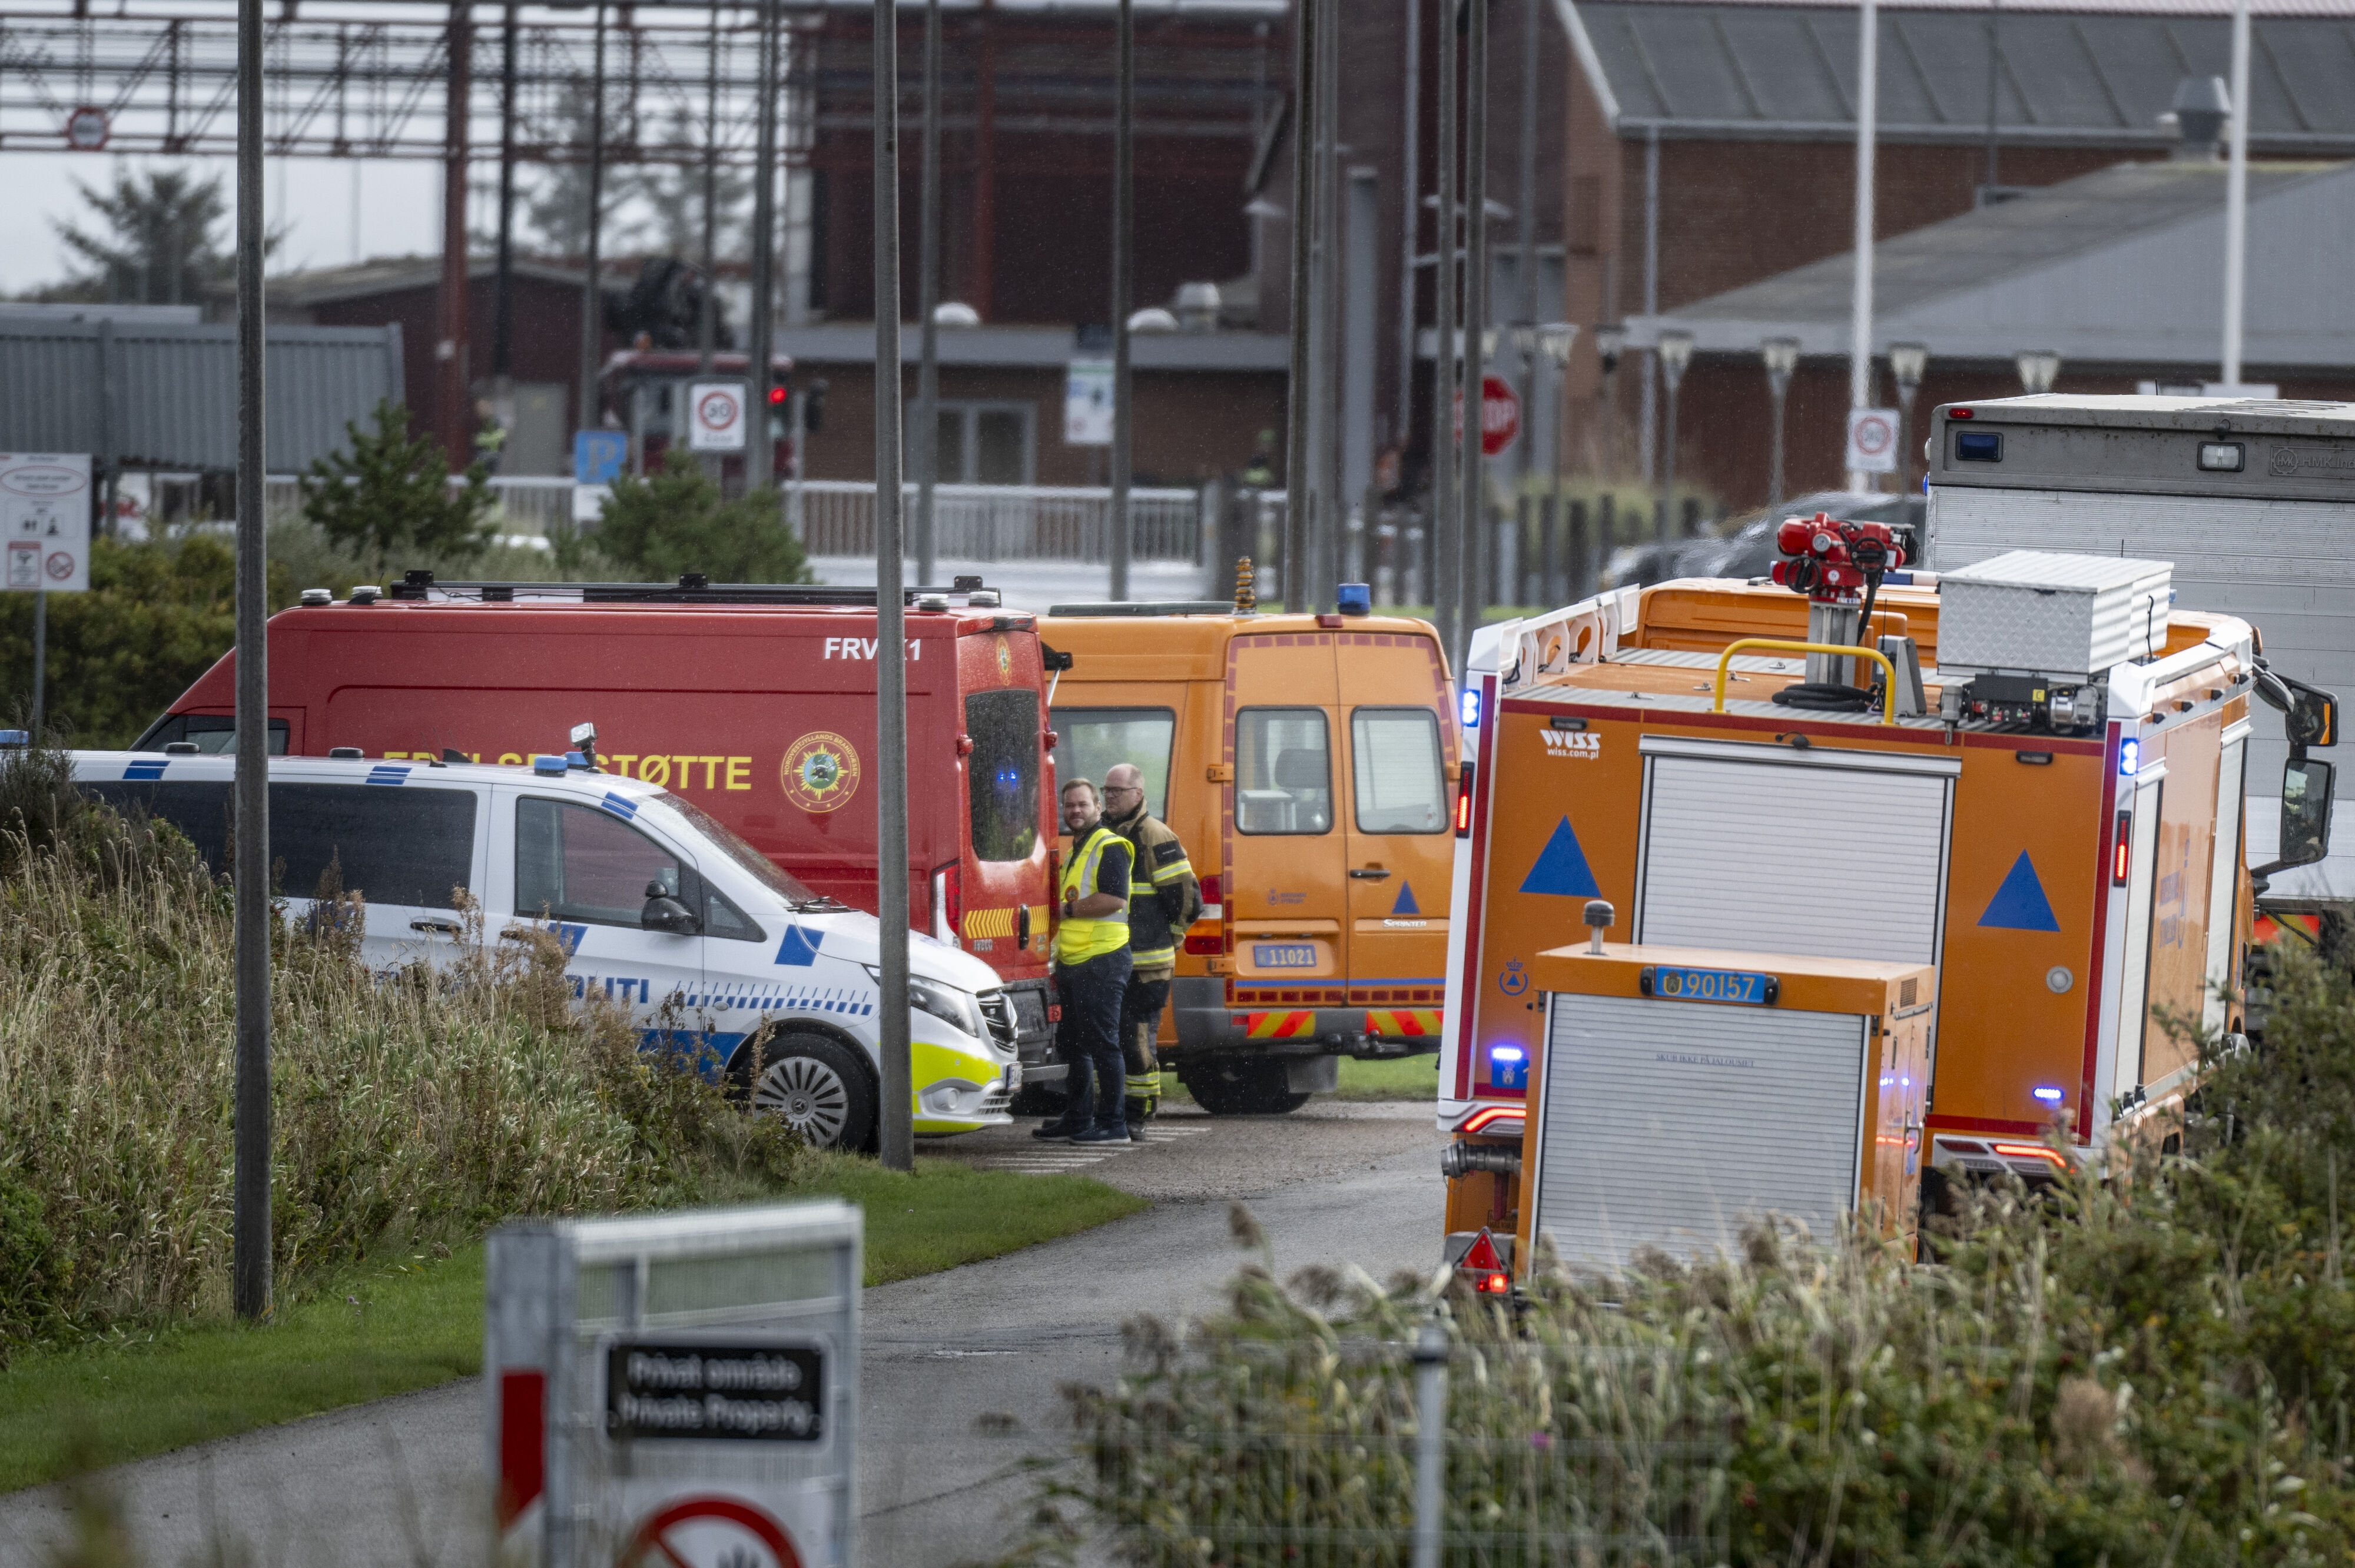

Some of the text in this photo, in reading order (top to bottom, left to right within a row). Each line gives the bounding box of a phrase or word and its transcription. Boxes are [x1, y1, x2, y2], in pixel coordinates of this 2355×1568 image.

[588, 440, 615, 476] P
[2302, 457, 2332, 468] HMK
[1547, 747, 1599, 760] wiss.com.pl
[1270, 949, 1315, 965] 11021
[1687, 974, 1755, 999] 90157
